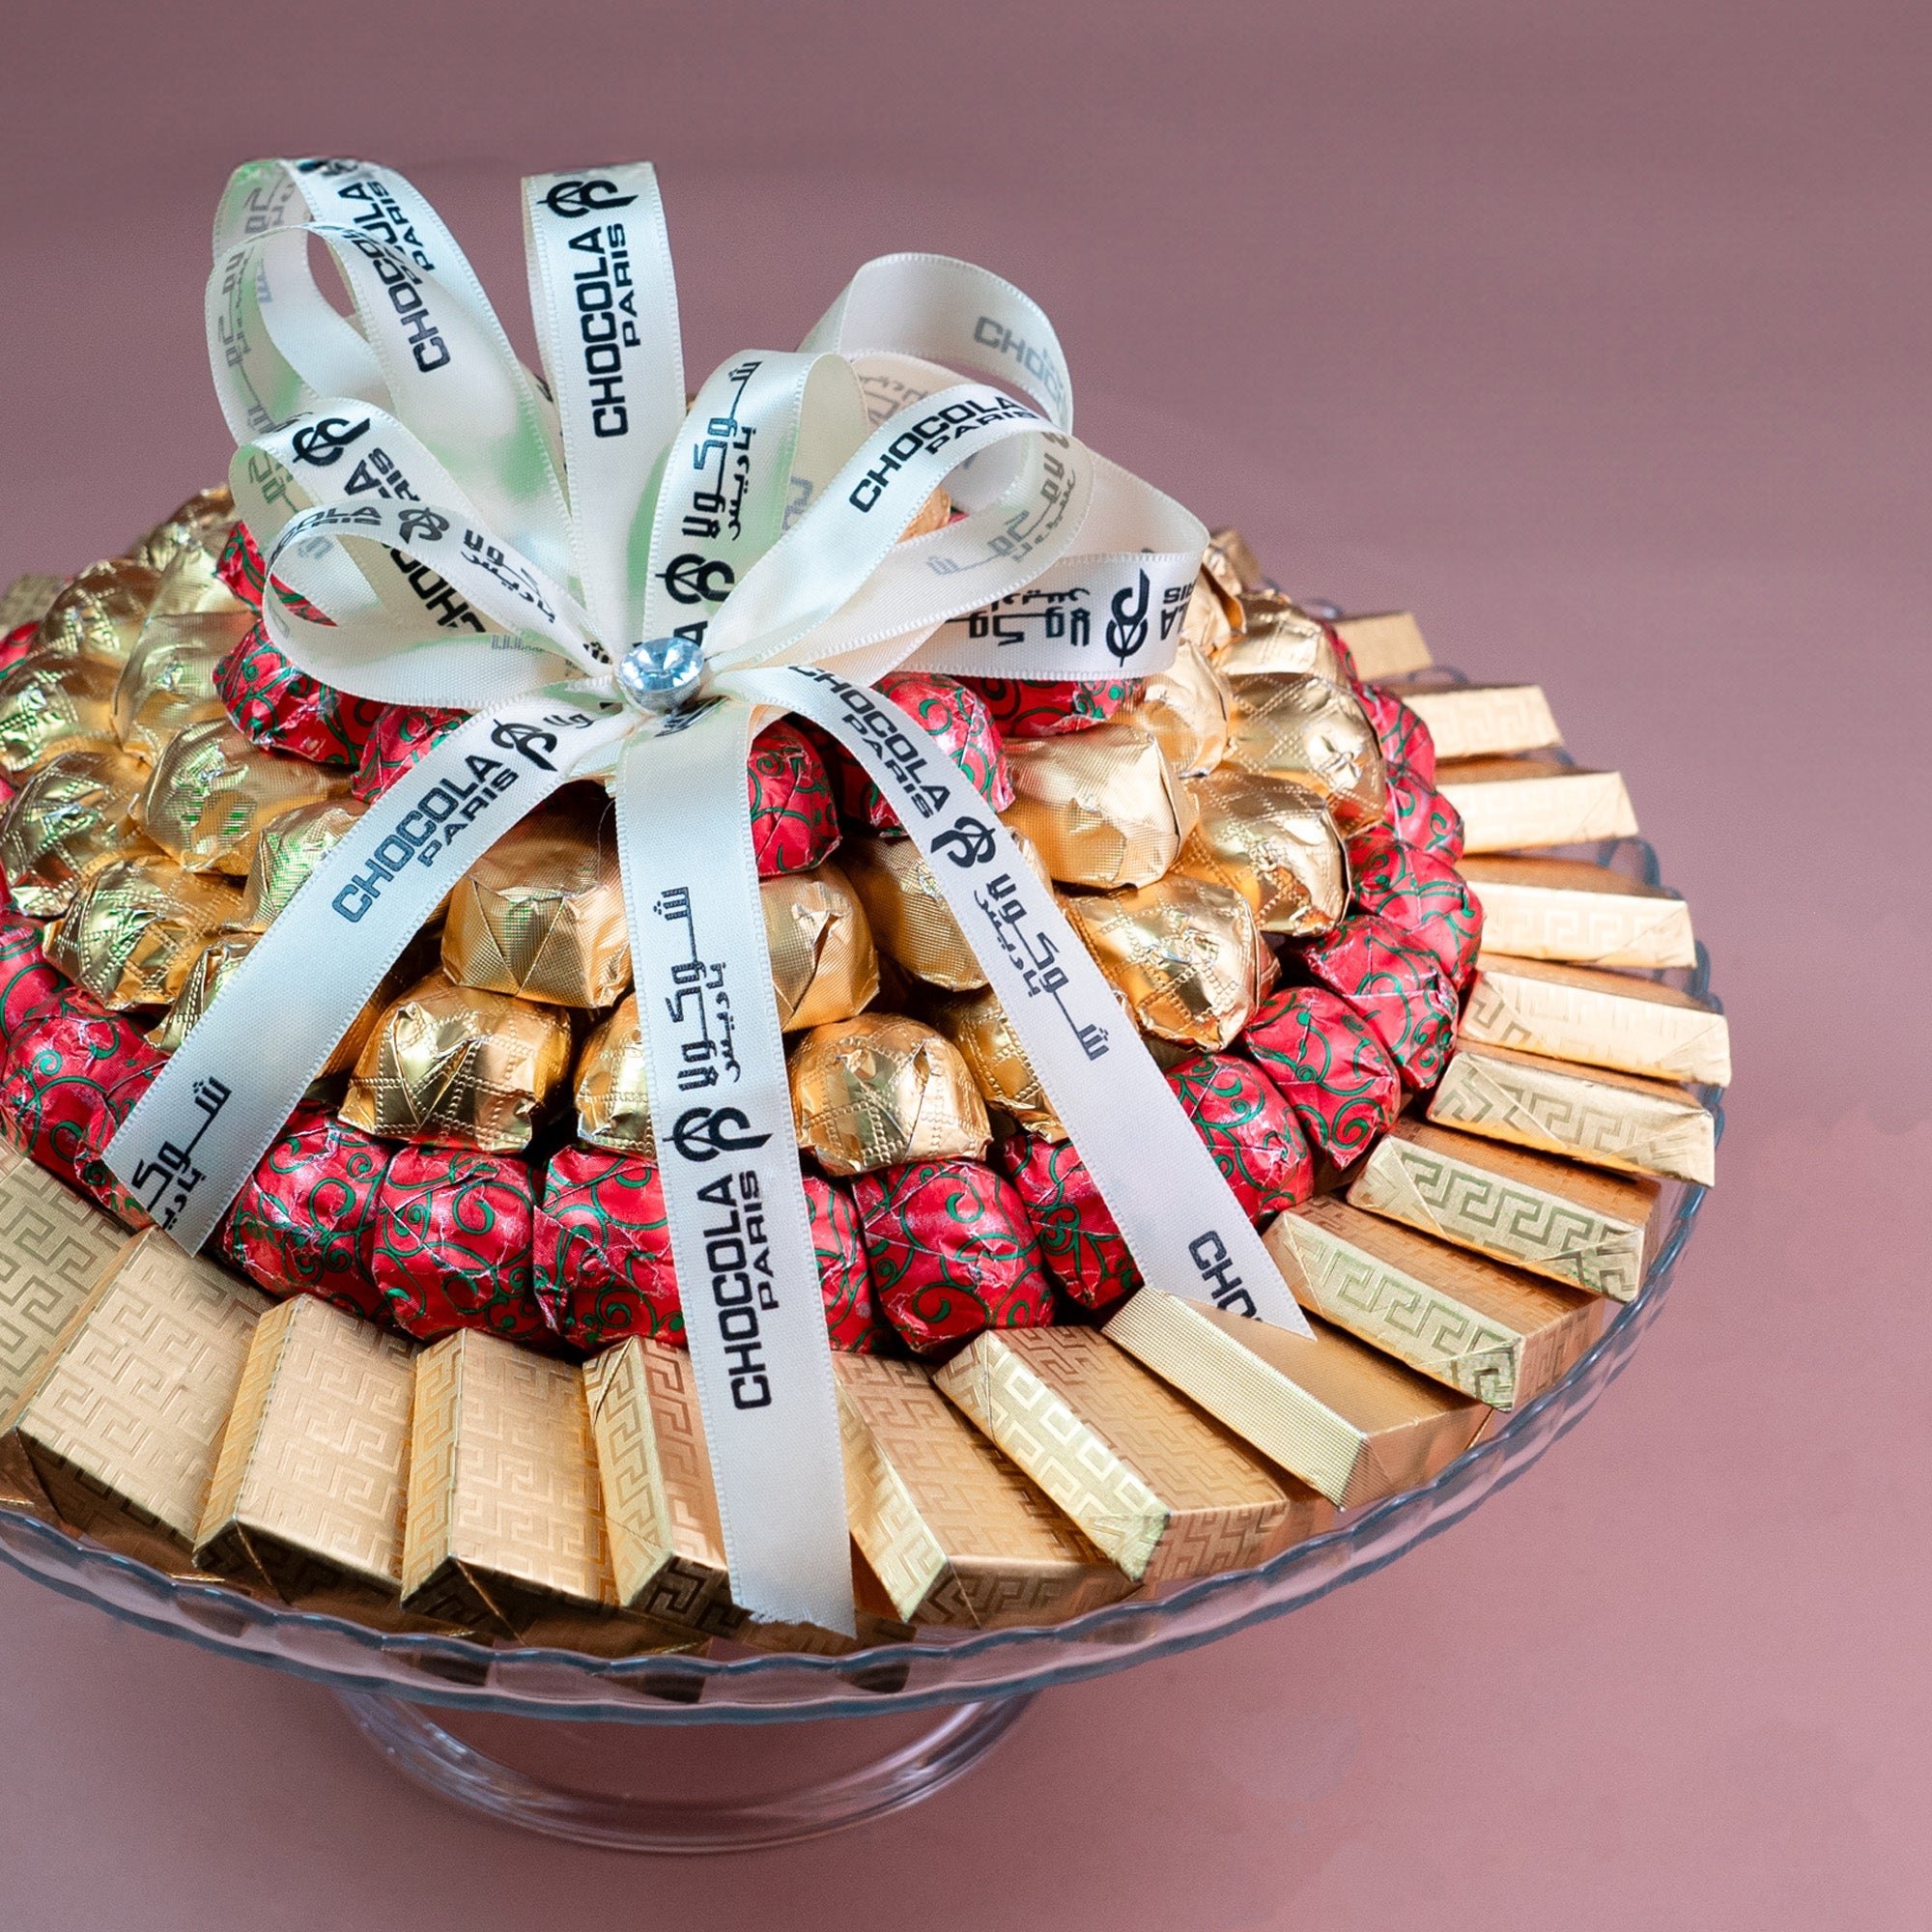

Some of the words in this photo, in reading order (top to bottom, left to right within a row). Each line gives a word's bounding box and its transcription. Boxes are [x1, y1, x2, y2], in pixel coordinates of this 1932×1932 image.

[367, 181, 436, 271] PARIS
[607, 222, 641, 349] PARIS
[568, 226, 629, 439] CHOCOLA
[681, 361, 762, 539] شوكولا
[728, 426, 756, 541] باريس
[849, 396, 1028, 513] CHOCOLA
[924, 412, 1039, 455] PARIS
[788, 666, 952, 811] CHOCOLA
[842, 714, 934, 819] PARIS
[331, 754, 503, 923] CHOCOLA
[417, 768, 519, 867] PARIS
[653, 886, 720, 1092] شوكولا
[974, 890, 1041, 998] باريس
[986, 873, 1110, 1061] شوكولا
[706, 962, 741, 1083] باريس
[696, 1173, 773, 1410] CHOCOLA
[738, 1170, 780, 1310] PARIS
